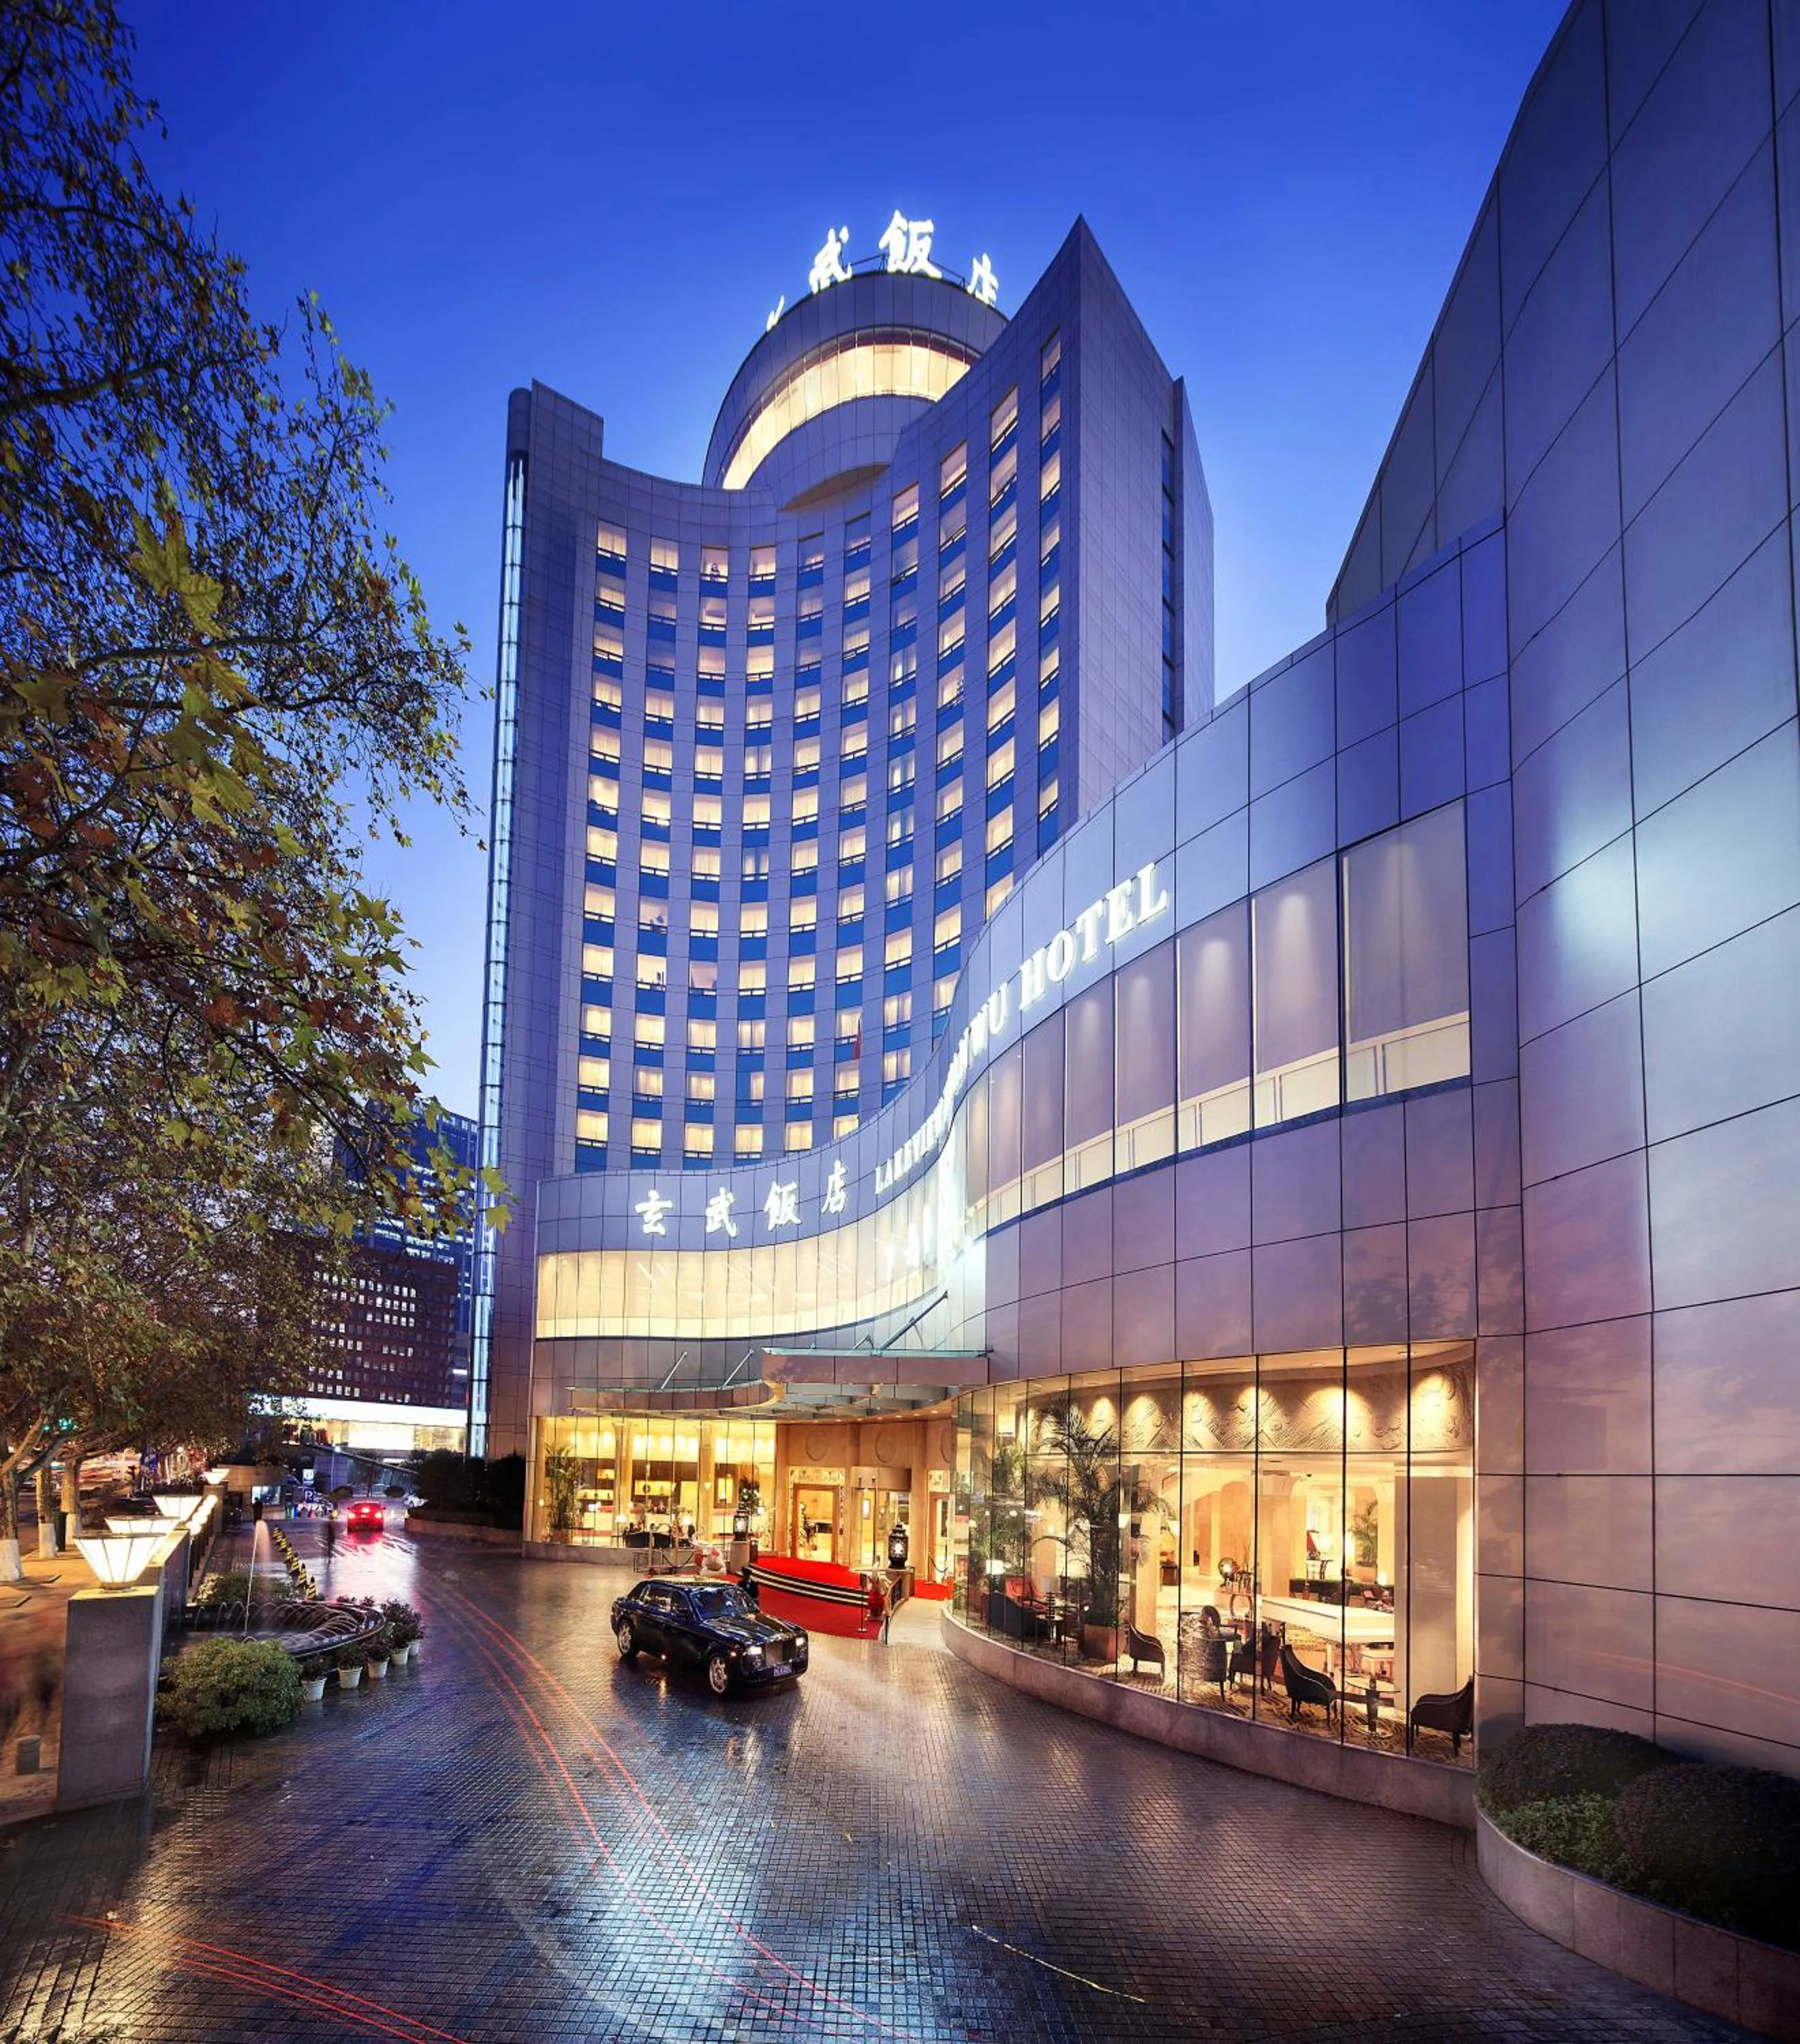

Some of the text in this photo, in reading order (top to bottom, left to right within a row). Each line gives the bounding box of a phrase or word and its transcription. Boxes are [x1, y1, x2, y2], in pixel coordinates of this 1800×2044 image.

[1019, 862, 1167, 1010] HOTEL
[634, 1160, 851, 1237] 玄武飯店
